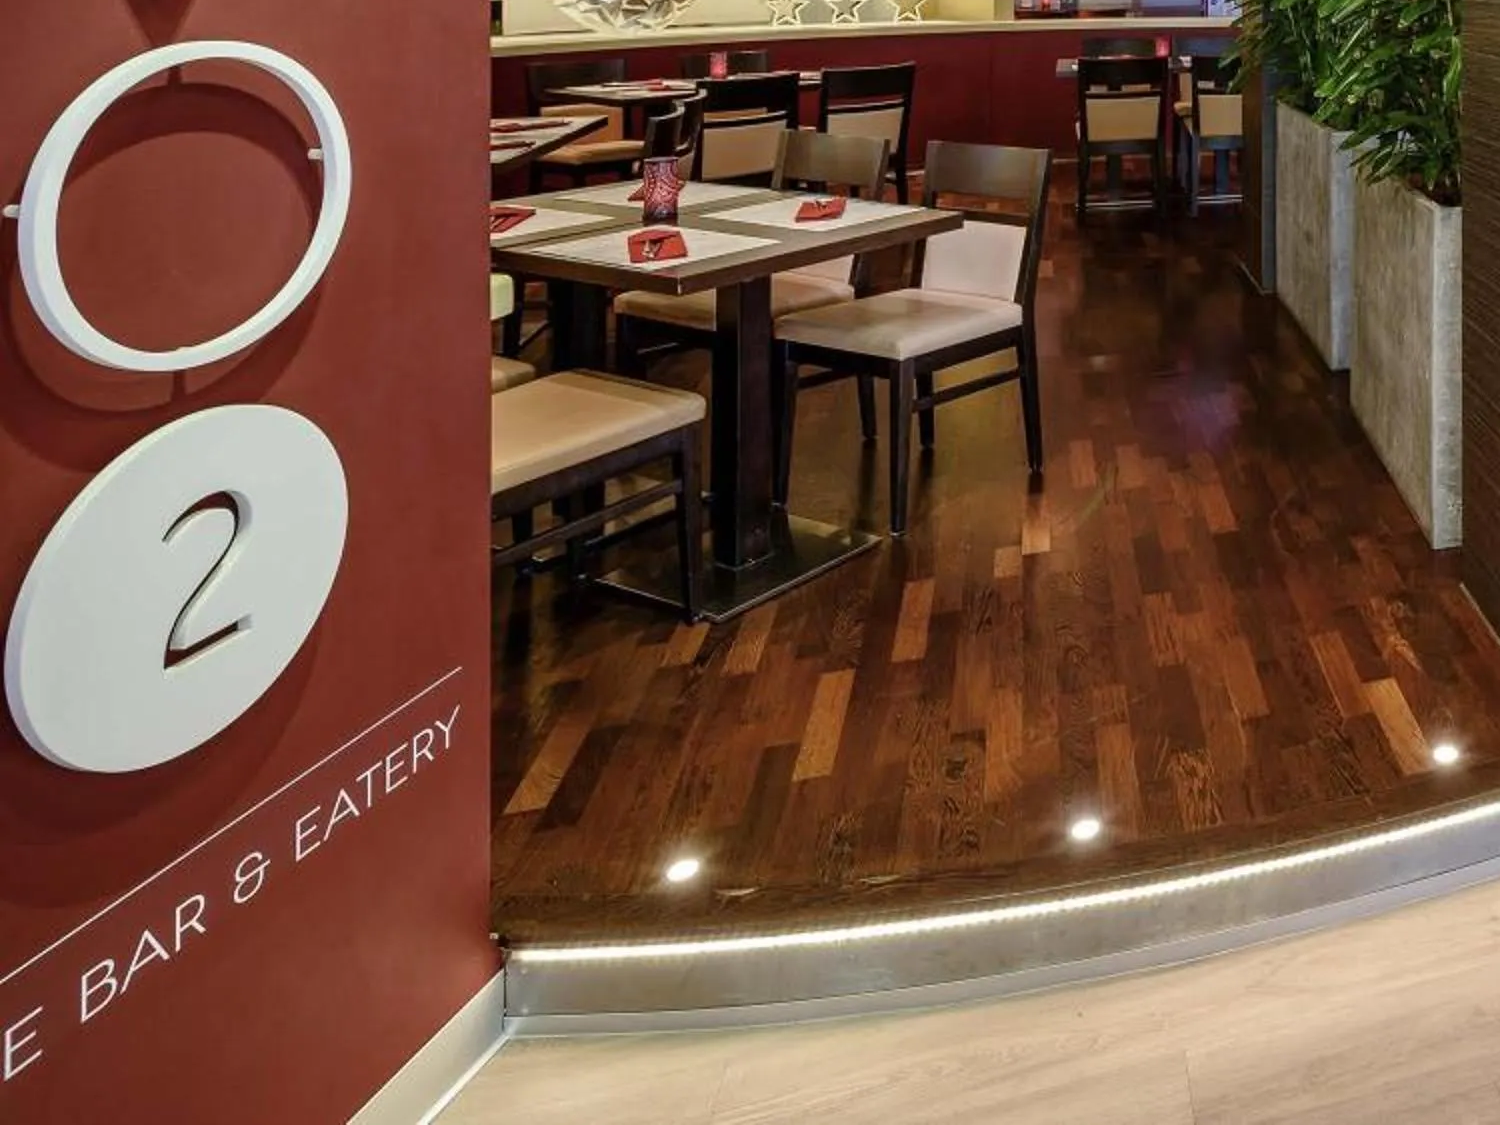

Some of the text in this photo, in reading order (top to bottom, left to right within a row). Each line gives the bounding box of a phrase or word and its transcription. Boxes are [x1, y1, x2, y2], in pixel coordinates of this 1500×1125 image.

[79, 893, 207, 1024] BAR
[233, 851, 271, 905] &
[294, 704, 461, 863] EATERY
